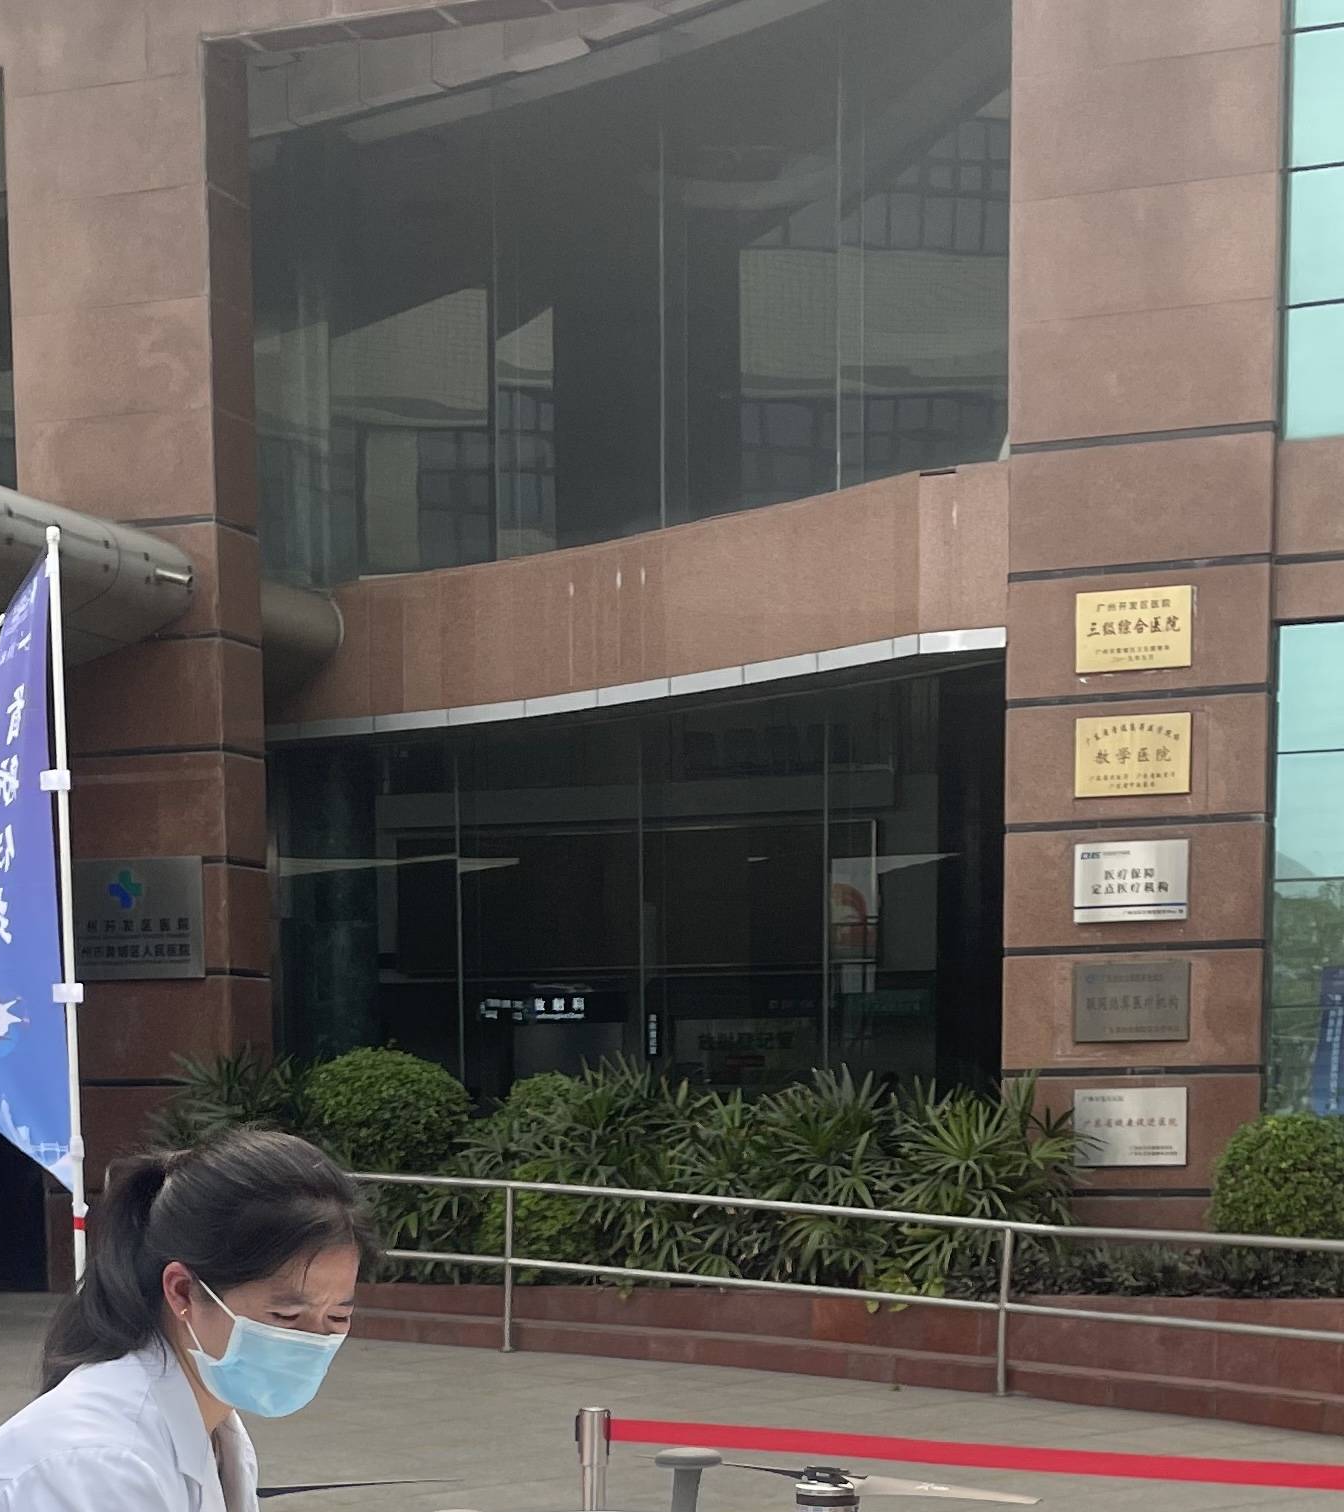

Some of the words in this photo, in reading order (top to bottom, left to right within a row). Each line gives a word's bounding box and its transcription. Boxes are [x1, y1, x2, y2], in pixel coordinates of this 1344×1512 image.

[1087, 615, 1181, 637] 三级综合医院
[1094, 746, 1172, 764] 教学医院
[1104, 867, 1155, 880] 医疗保障
[1091, 881, 1169, 895] 定点医疗机构
